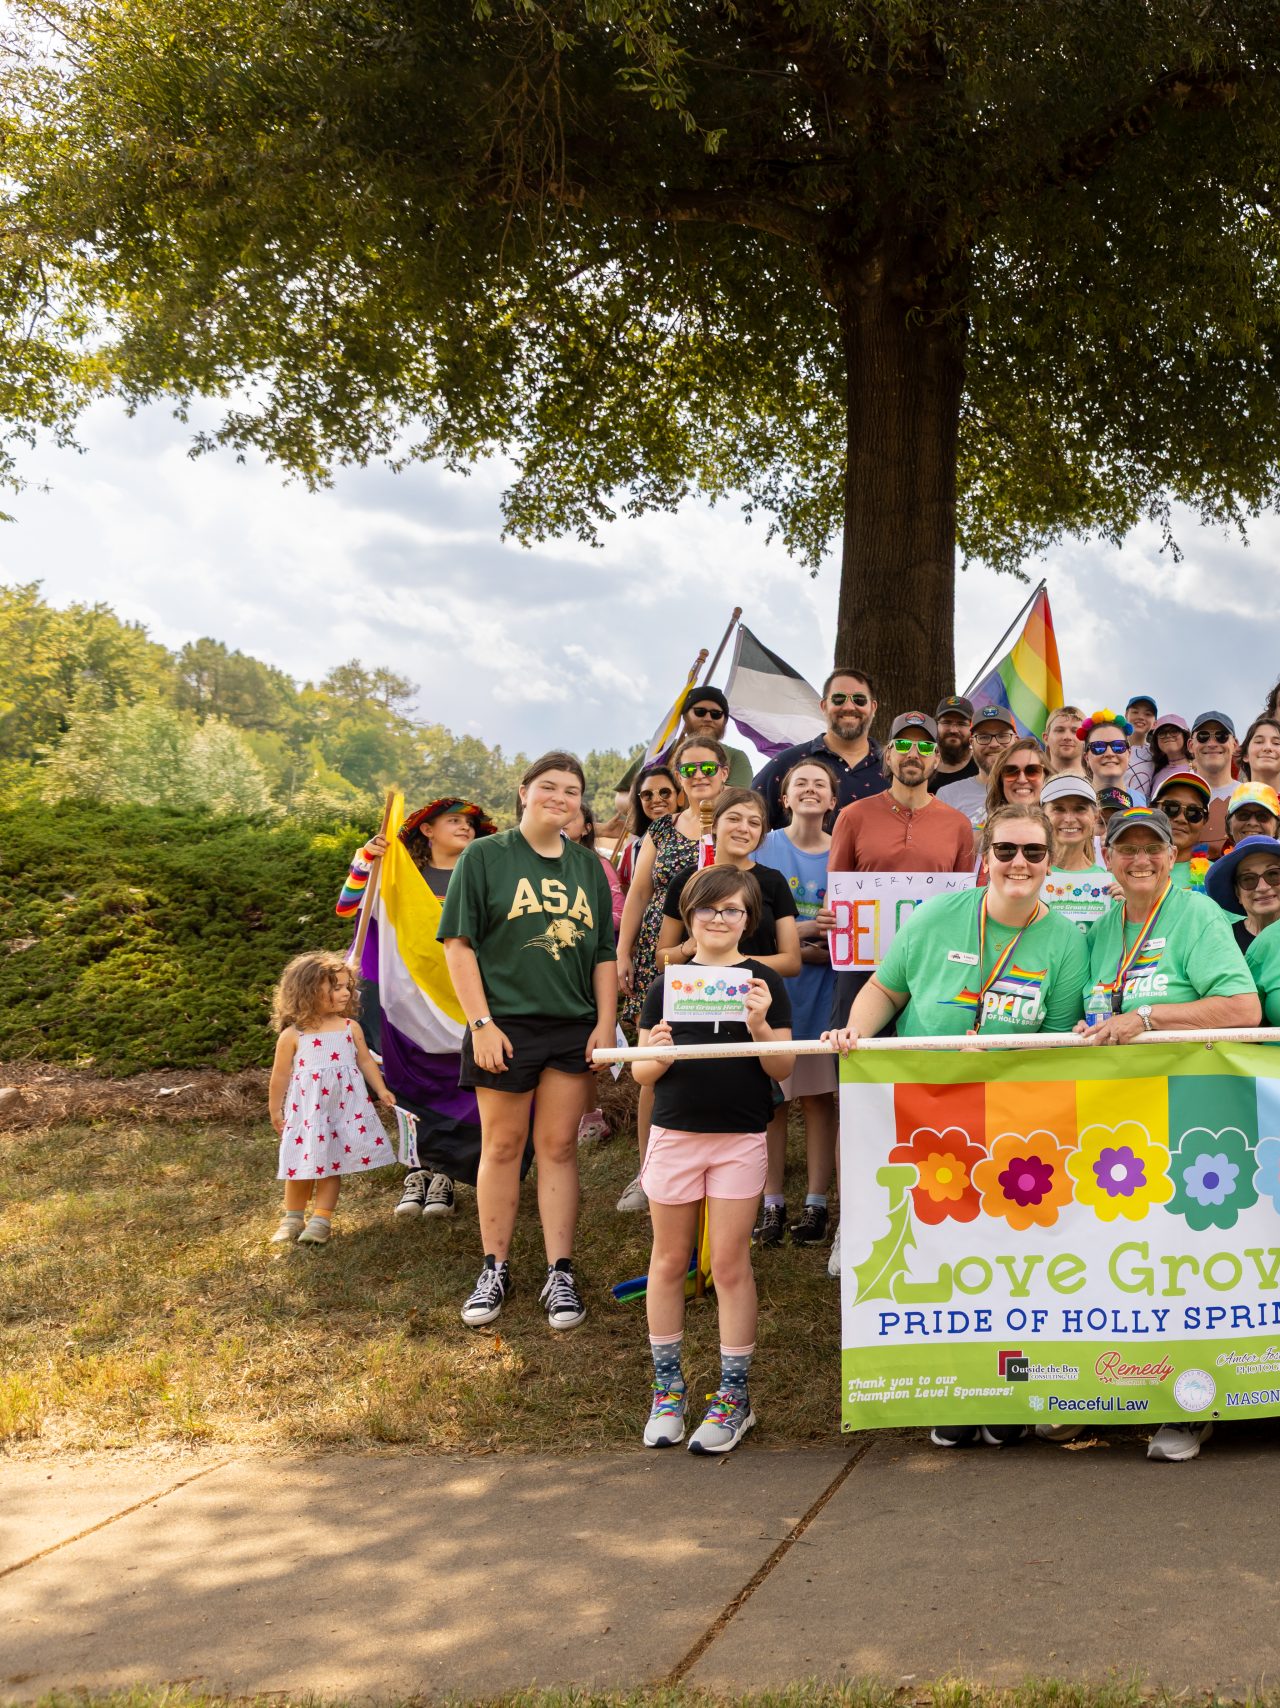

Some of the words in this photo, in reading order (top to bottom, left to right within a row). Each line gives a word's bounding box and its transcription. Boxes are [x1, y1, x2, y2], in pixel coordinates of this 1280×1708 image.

[507, 877, 594, 930] ASA
[1122, 972, 1169, 994] ride
[980, 987, 1046, 1027] prid
[998, 1015, 1021, 1025] HOLLY
[852, 1165, 1087, 1305] Love
[878, 1309, 993, 1336] PRIDE
[1006, 1307, 1049, 1333] OF
[1062, 1308, 1170, 1334] HOLLY
[1095, 1351, 1175, 1382] Remedy
[1216, 1351, 1259, 1366] Amber
[1011, 1364, 1045, 1374] Outside
[1045, 1364, 1061, 1373] the
[1062, 1364, 1079, 1374] Box
[848, 1376, 887, 1391] Thank
[889, 1377, 914, 1391] you
[918, 1376, 931, 1385] to
[935, 1375, 958, 1385] our
[848, 1388, 910, 1403] Champion
[914, 1386, 949, 1398] Level
[953, 1386, 1015, 1400] Sponsors!
[1226, 1389, 1280, 1406] MASON
[1048, 1396, 1114, 1411] Peaceful
[1116, 1397, 1149, 1411] Law
